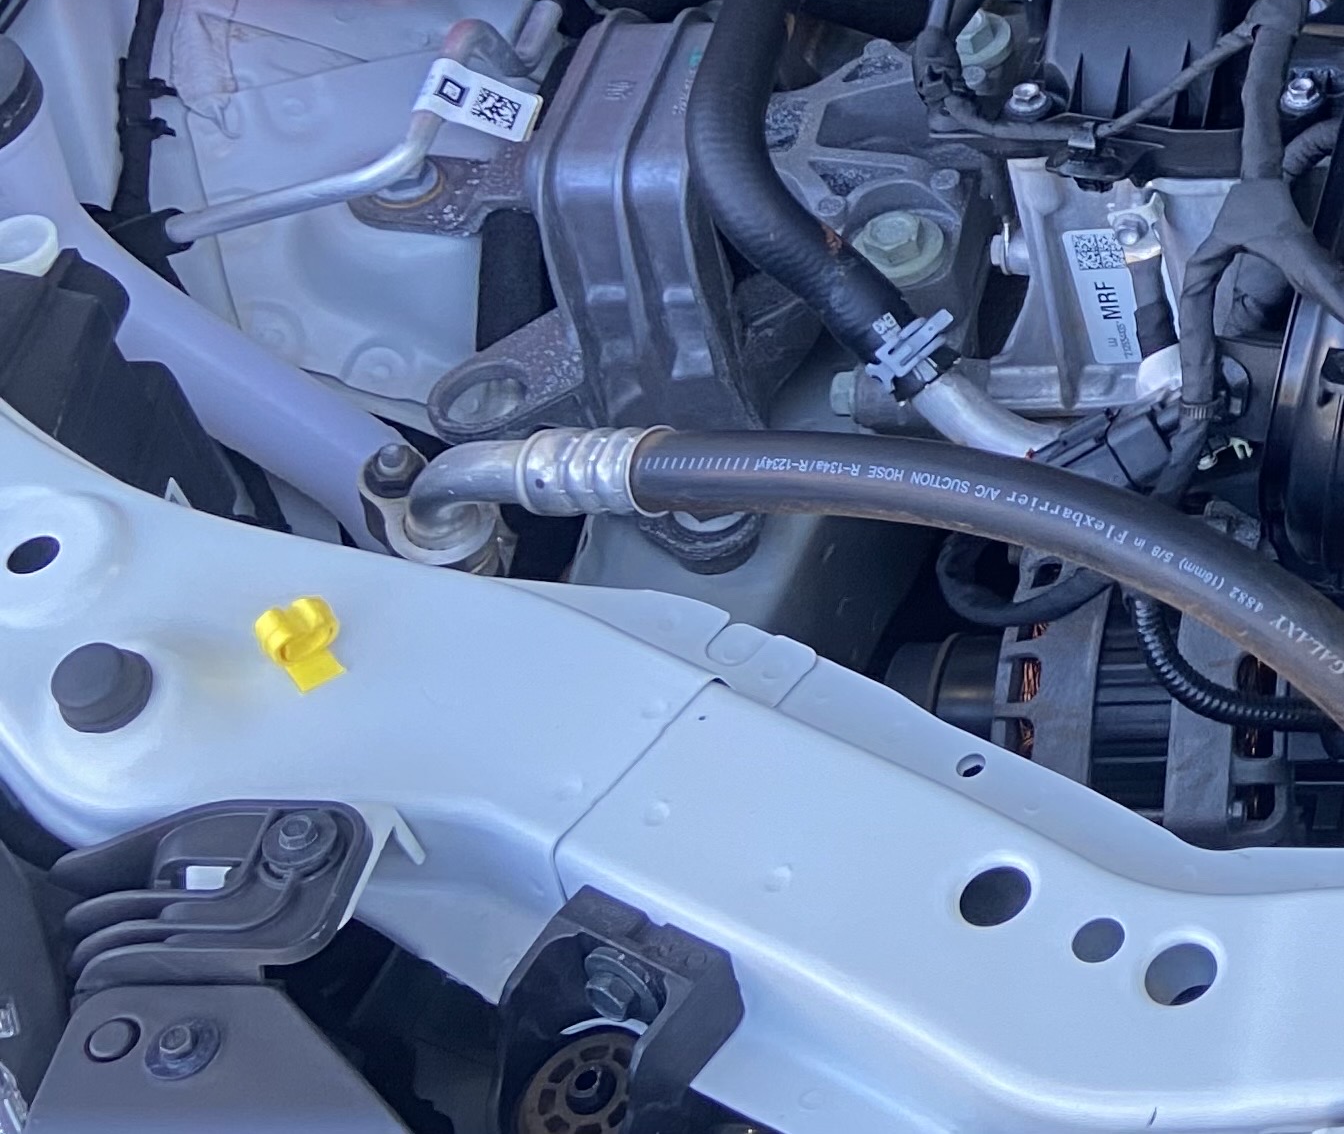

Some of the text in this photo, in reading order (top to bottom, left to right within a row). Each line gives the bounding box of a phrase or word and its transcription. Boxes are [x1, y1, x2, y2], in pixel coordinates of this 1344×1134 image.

[1094, 281, 1123, 320] MRF
[867, 465, 905, 482] HOSE
[910, 471, 971, 494] SUCTION
[974, 484, 1001, 501] A/C
[1006, 493, 1130, 545] Flexbarrier
[1151, 545, 1175, 563] 5/8
[1178, 557, 1225, 591] (16mm)
